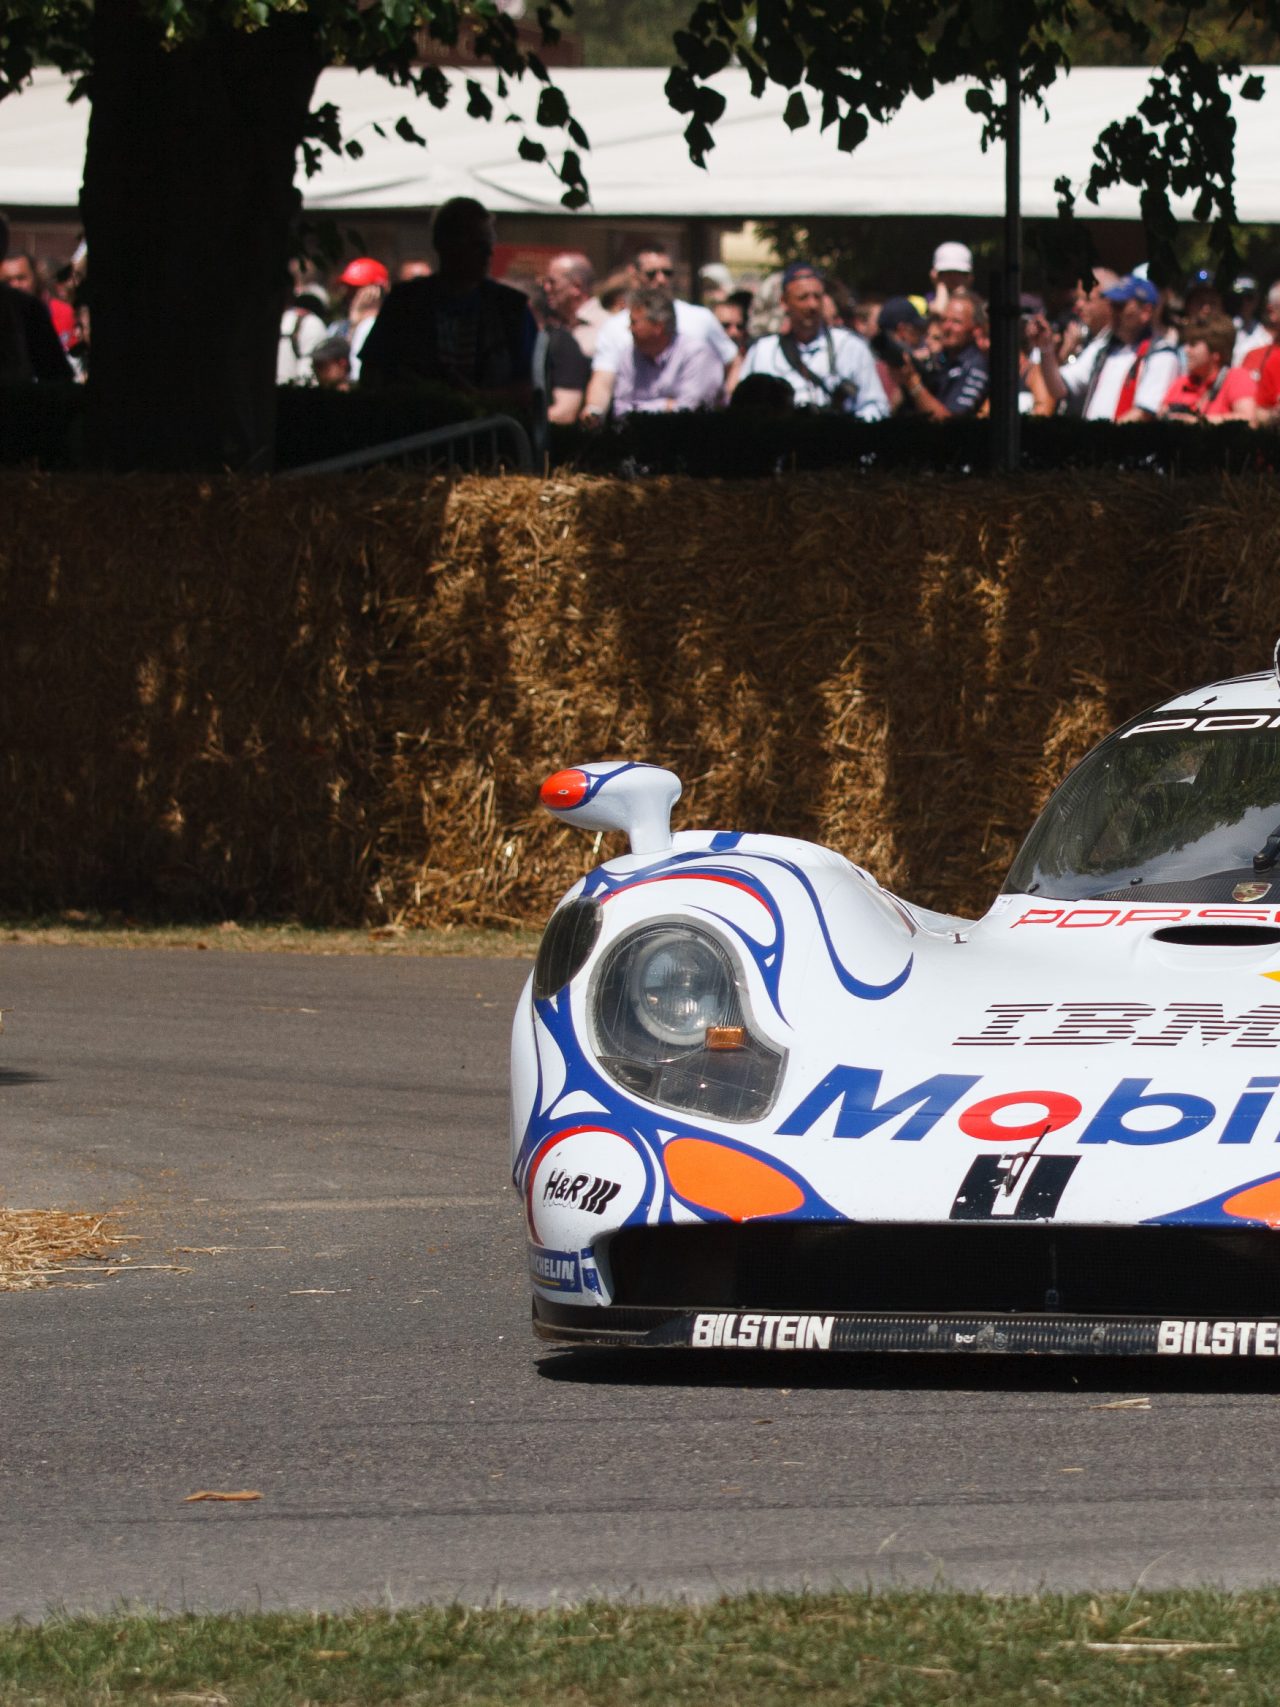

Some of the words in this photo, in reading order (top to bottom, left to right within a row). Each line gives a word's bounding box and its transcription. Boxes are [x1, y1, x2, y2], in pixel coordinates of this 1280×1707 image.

[543, 1170, 590, 1205] H&R
[531, 1254, 575, 1280] CHELIN
[692, 1313, 836, 1349] BILSTEIN
